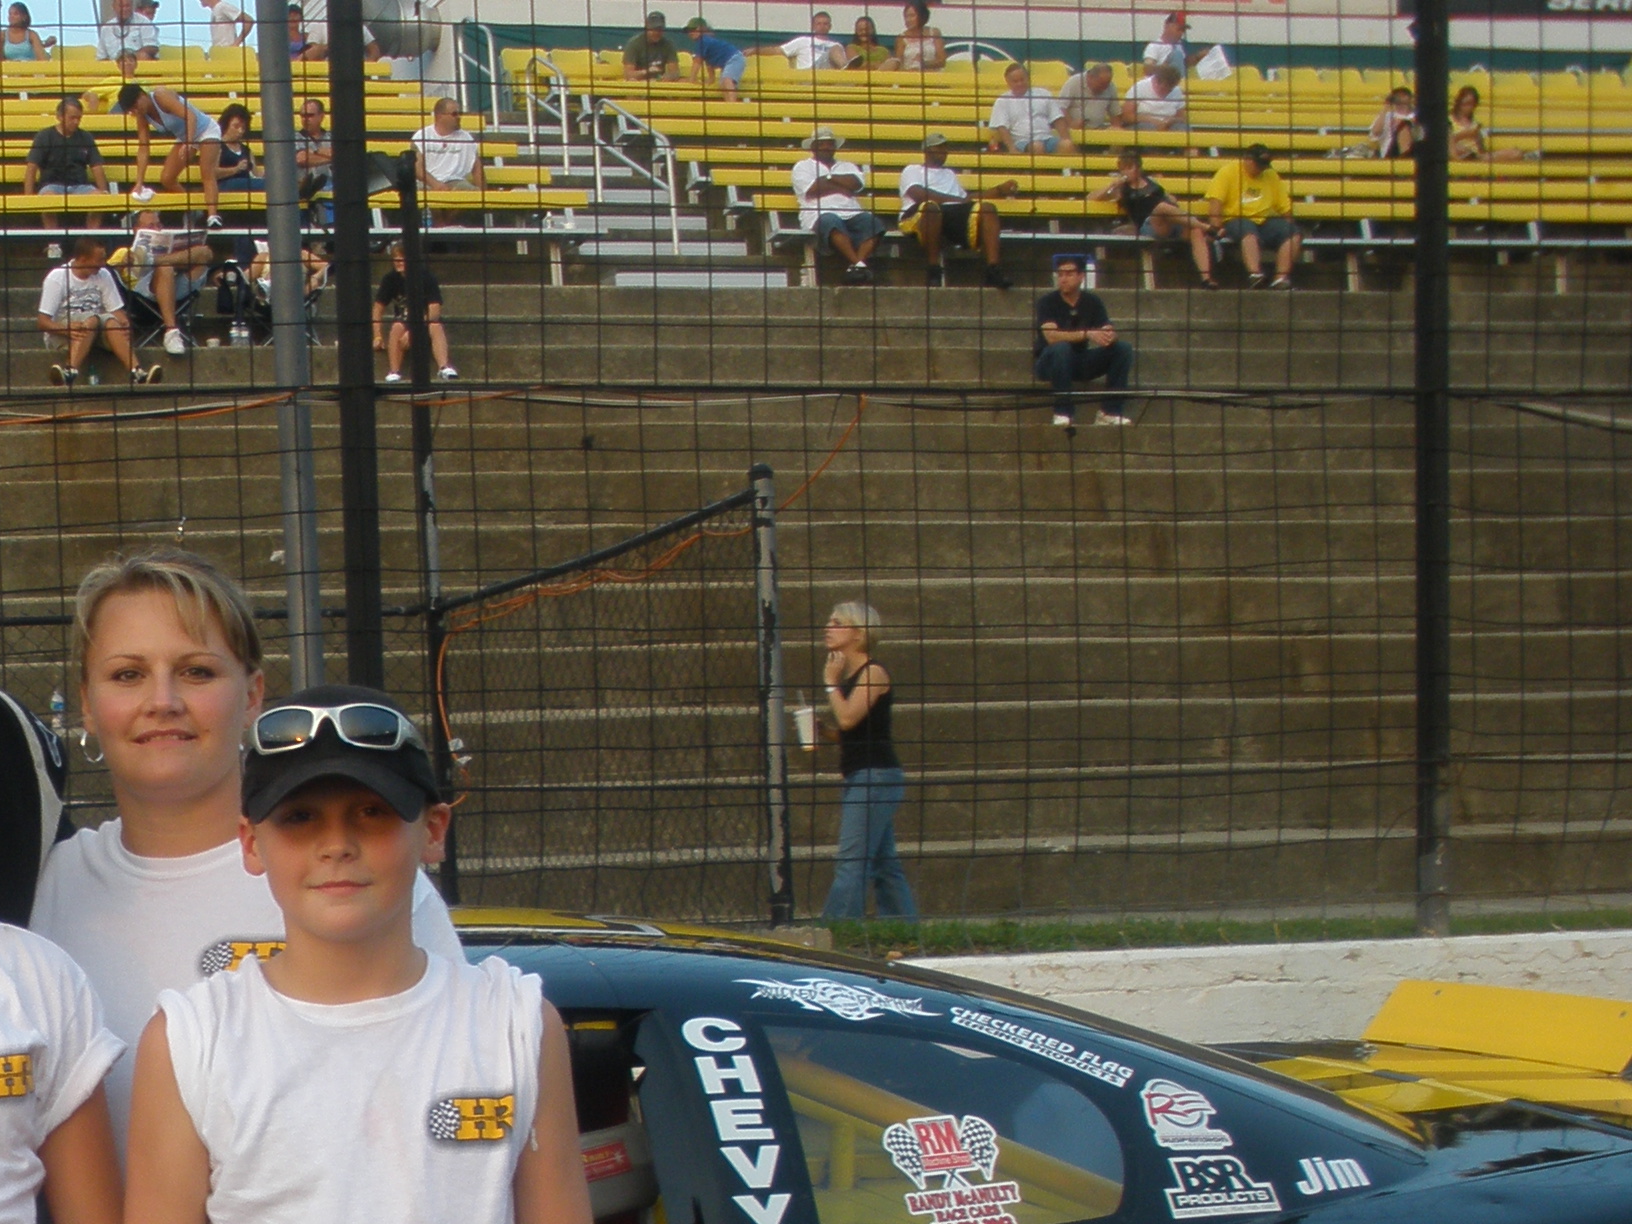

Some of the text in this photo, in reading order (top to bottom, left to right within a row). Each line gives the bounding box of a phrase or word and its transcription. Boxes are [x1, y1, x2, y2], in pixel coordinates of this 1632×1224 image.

[950, 1006, 1135, 1080] CHECKERED FLAG
[914, 1120, 962, 1155] RM
[1174, 1159, 1249, 1193] BSR
[1296, 1157, 1371, 1195] Jim
[907, 1191, 952, 1212] RANDY
[1175, 1190, 1270, 1207] PRODUCTS
[936, 1209, 968, 1223] RACE
